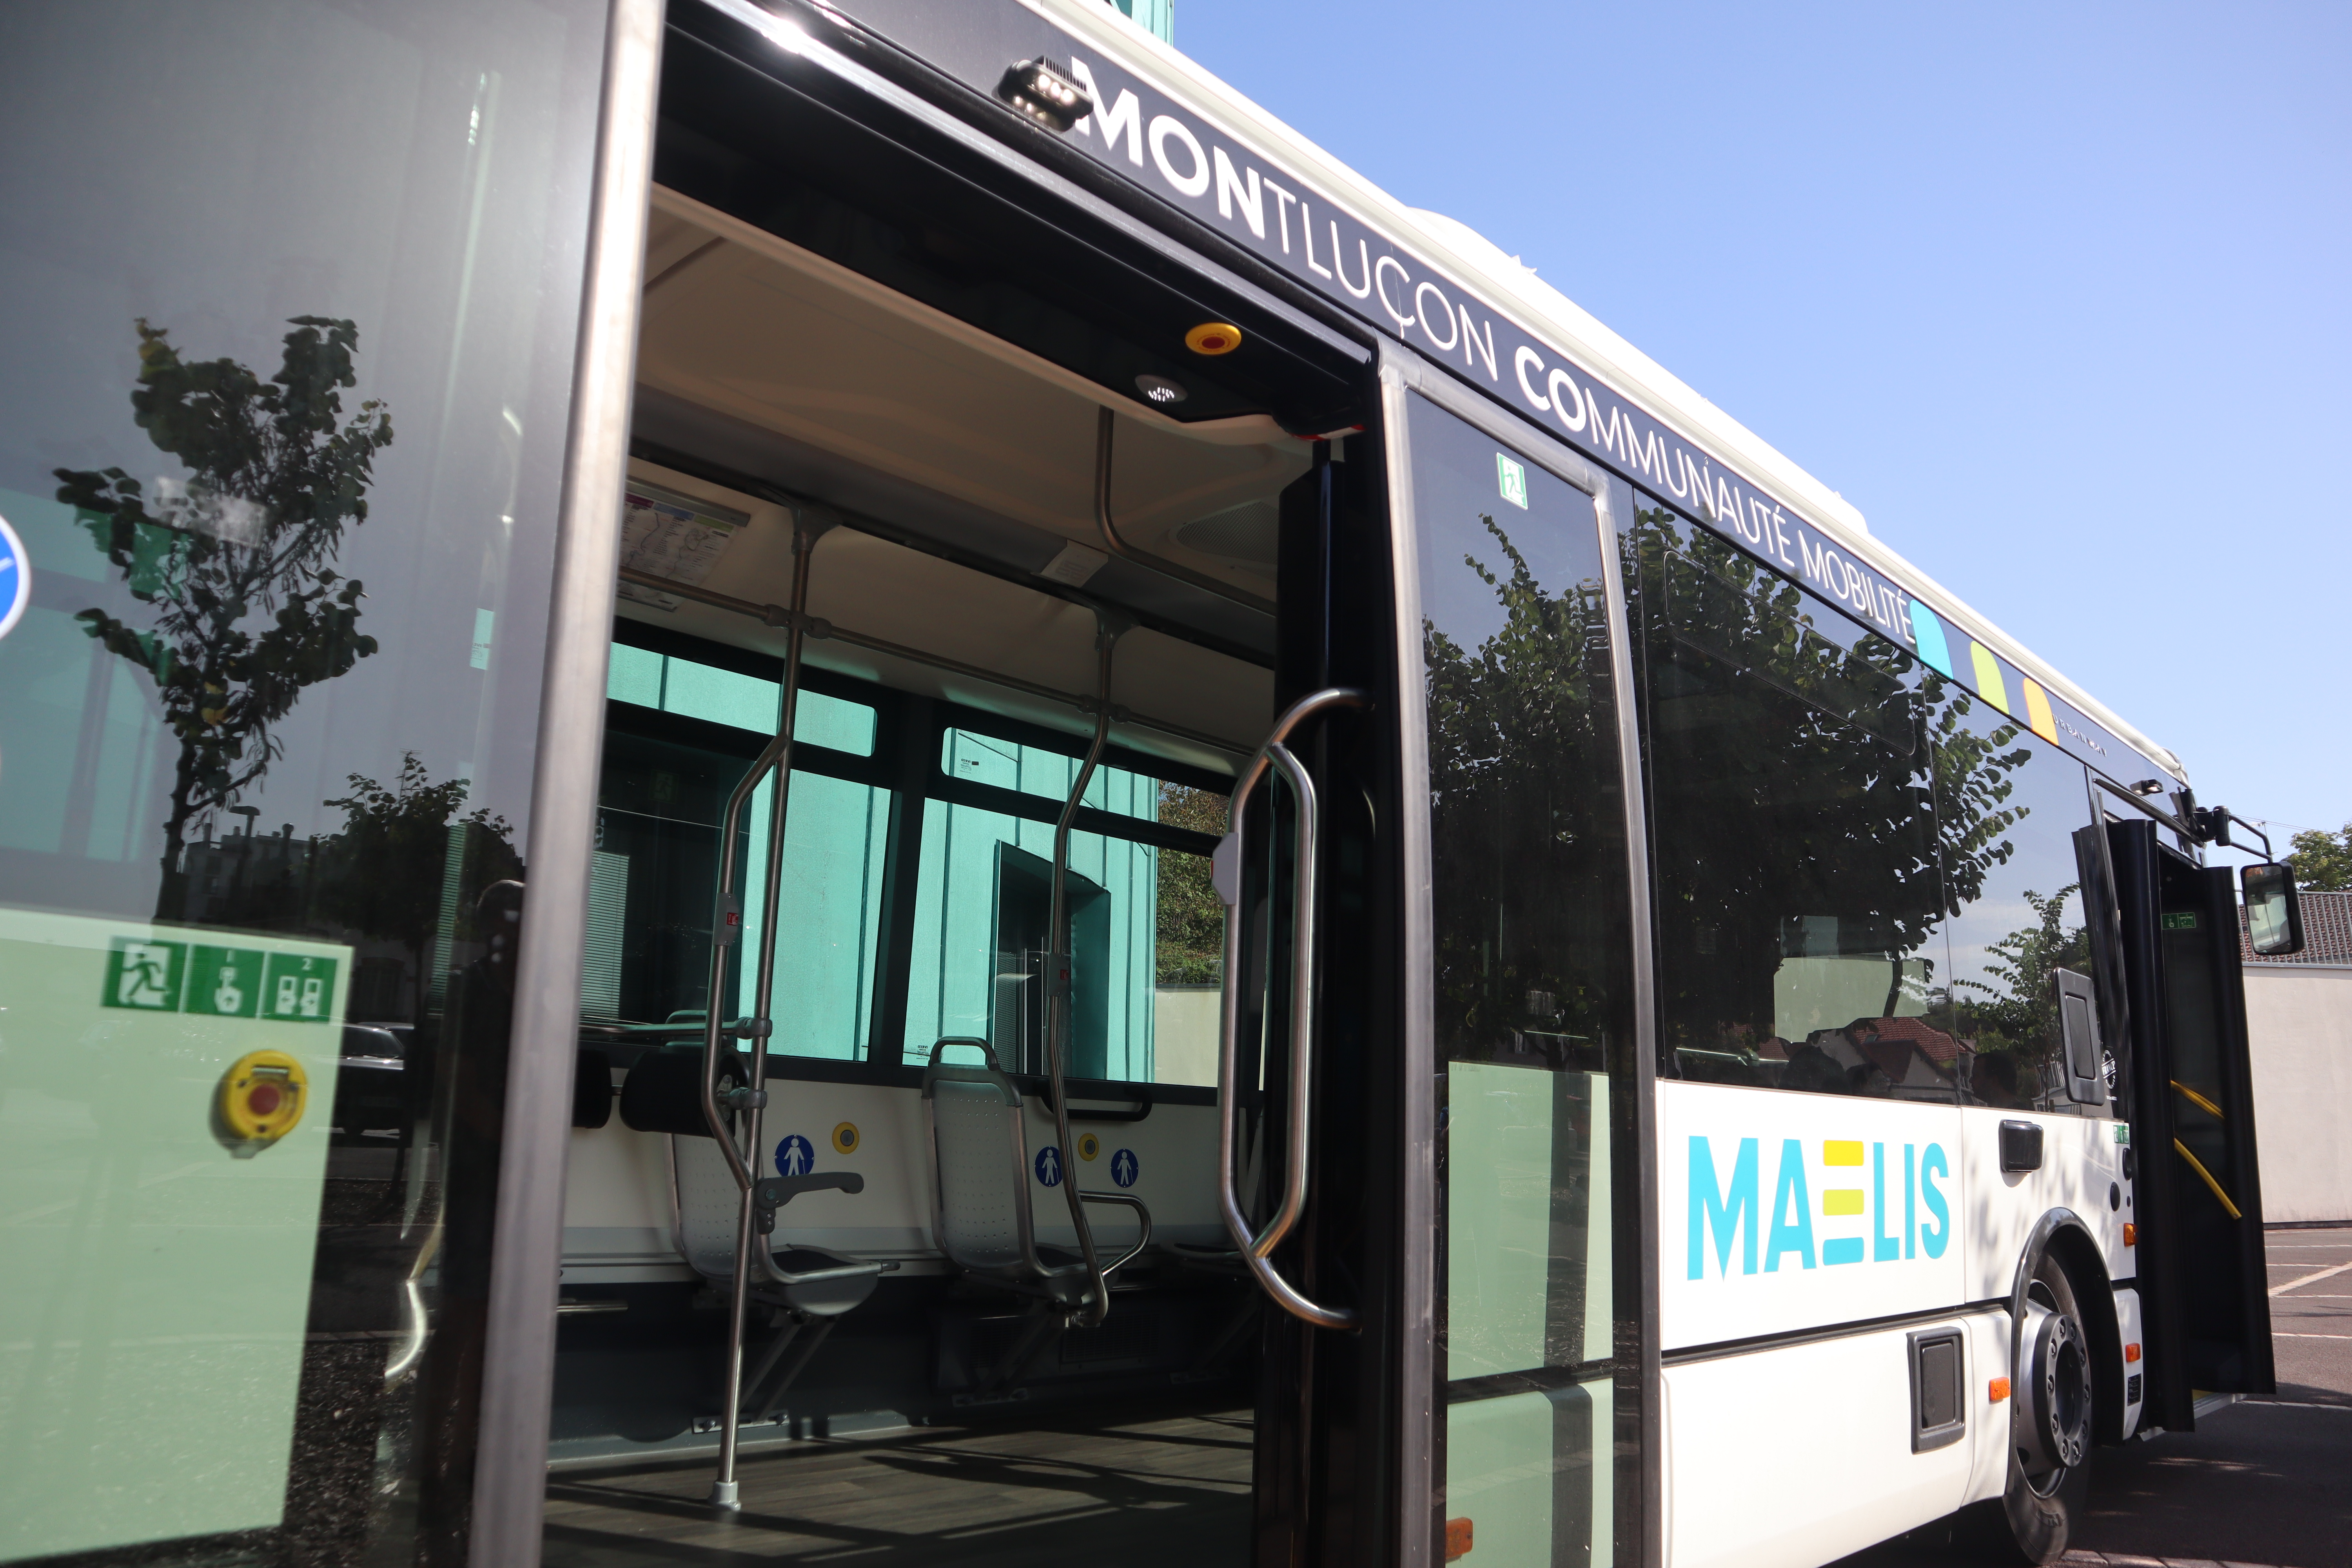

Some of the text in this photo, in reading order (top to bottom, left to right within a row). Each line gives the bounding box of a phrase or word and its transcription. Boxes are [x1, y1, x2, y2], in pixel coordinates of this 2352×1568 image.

[1071, 56, 1916, 644] MONTLUÇON COMMUNAUTÉ MOBILITÉ
[2053, 713, 2107, 757] URBANWAY
[301, 958, 312, 971] 2
[2102, 1060, 2116, 1076] FRANCE
[1687, 1136, 1950, 1281] MAELIS
